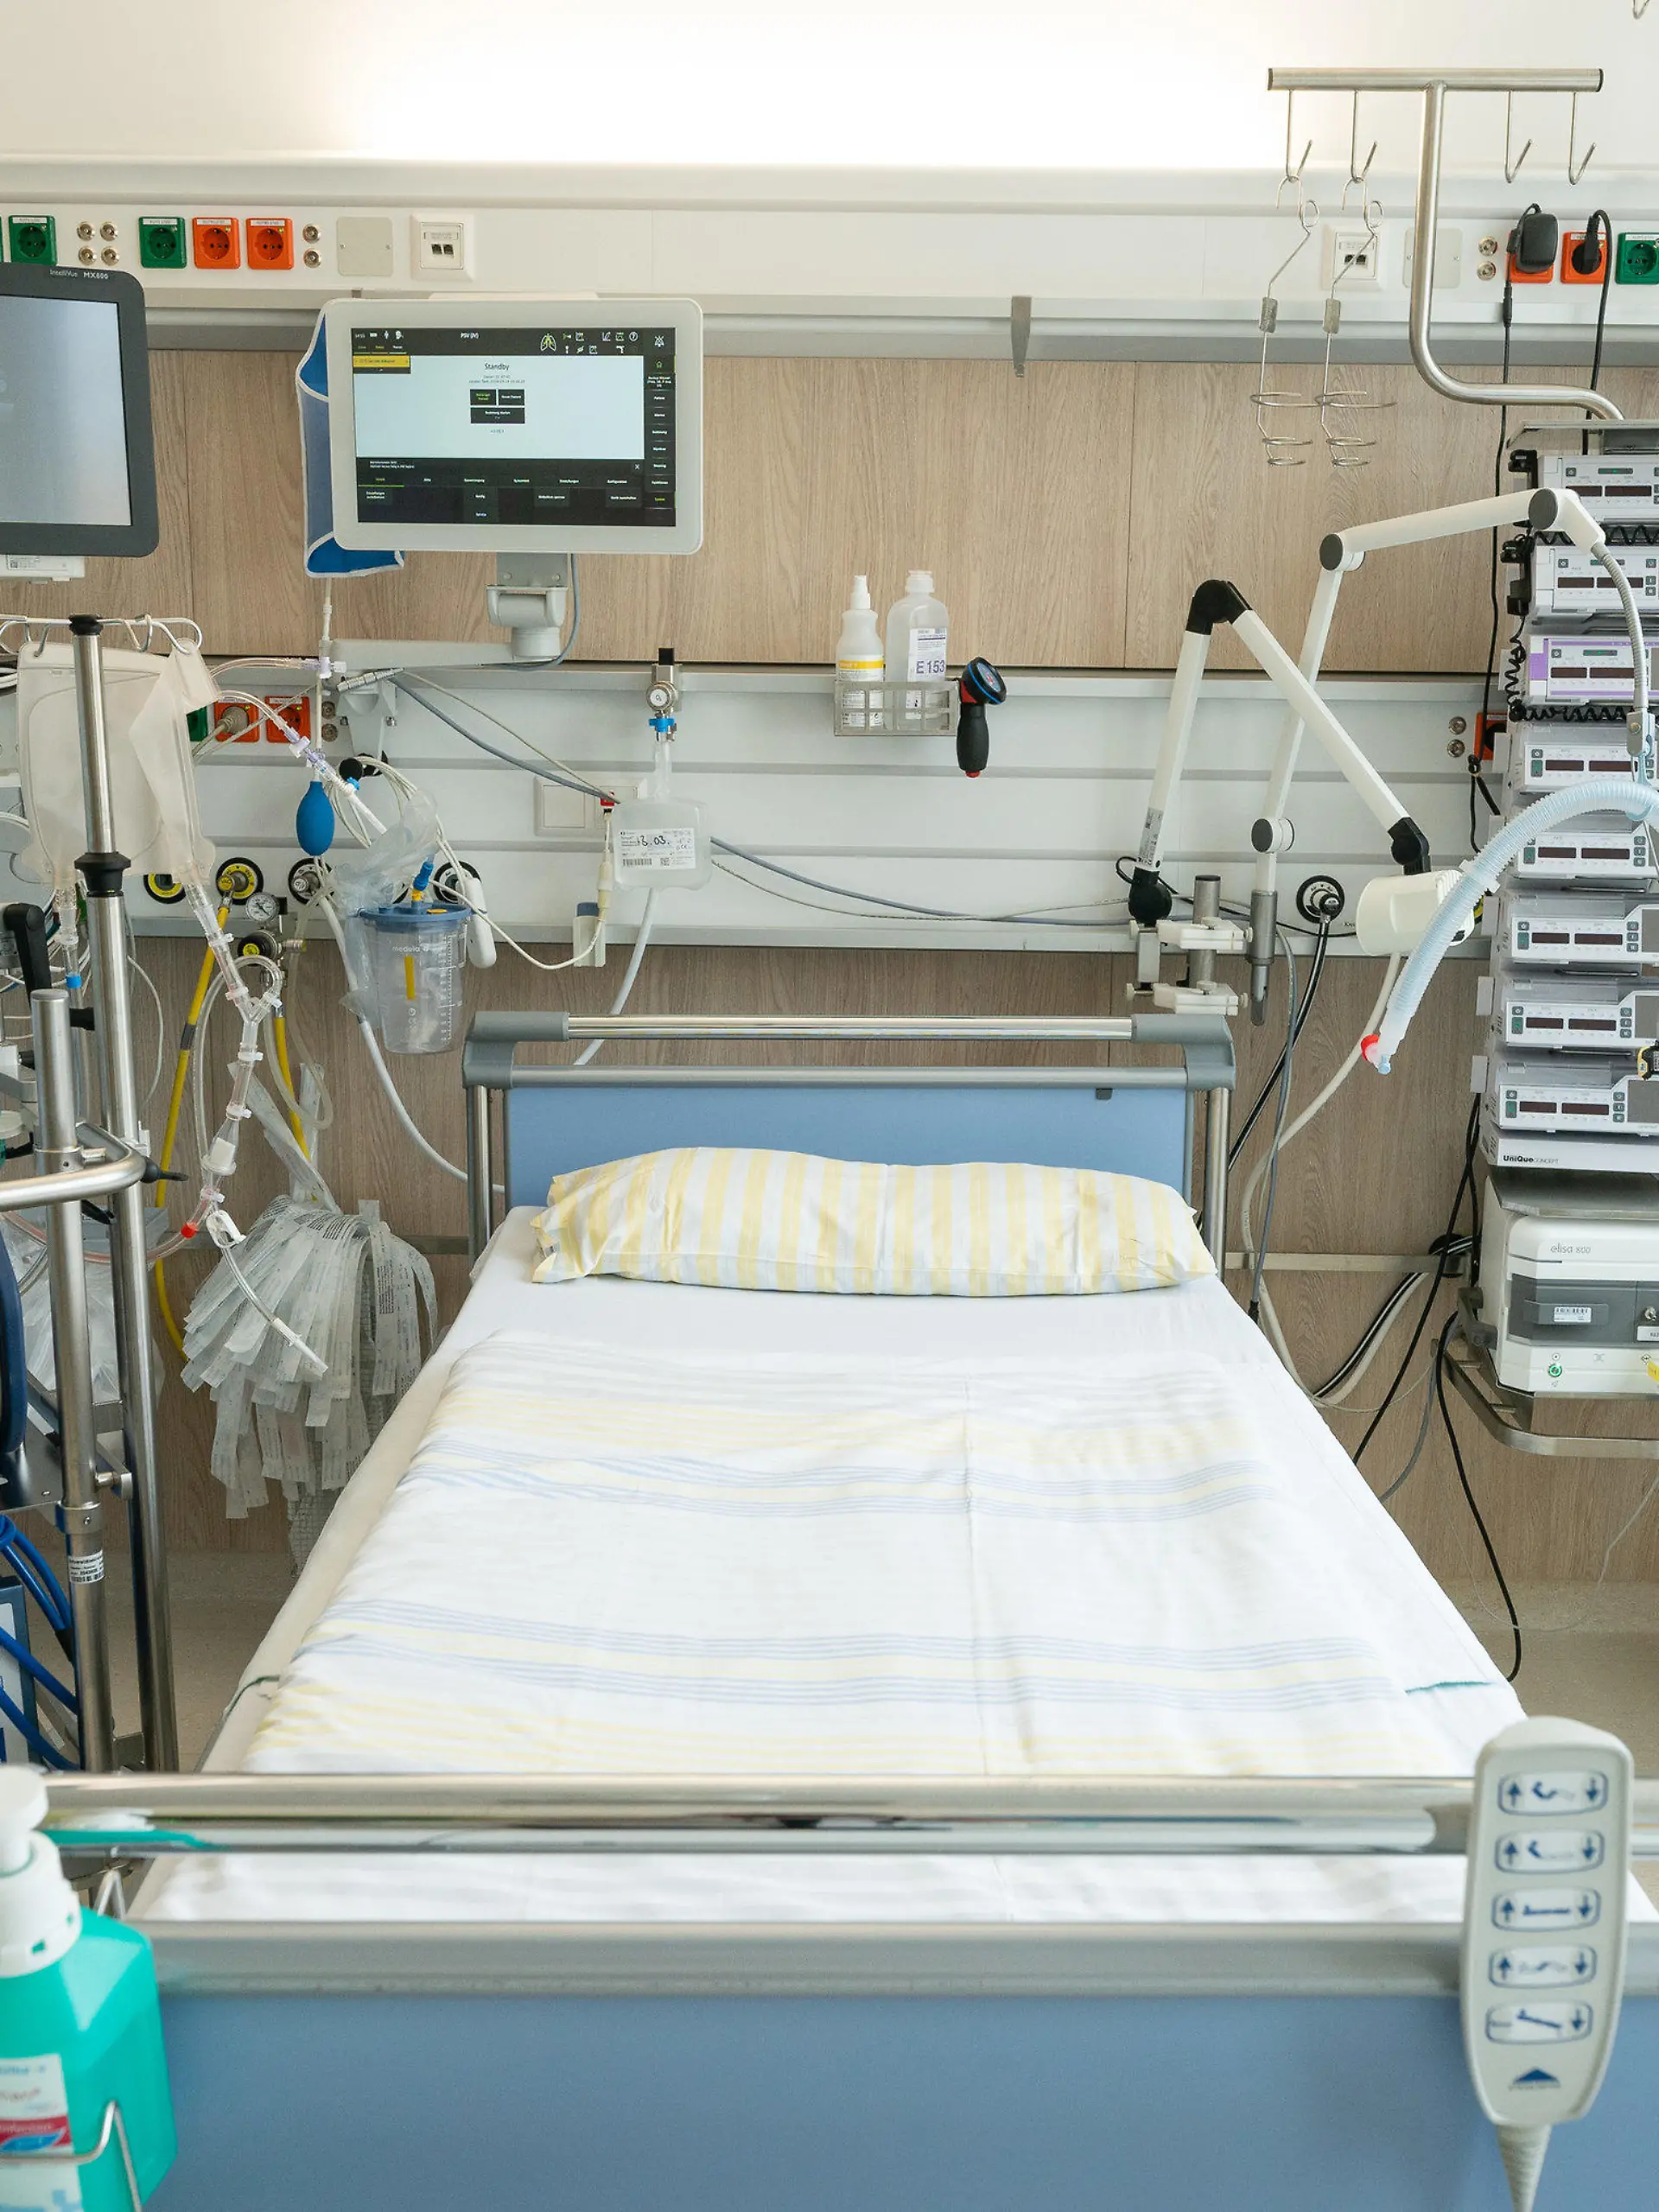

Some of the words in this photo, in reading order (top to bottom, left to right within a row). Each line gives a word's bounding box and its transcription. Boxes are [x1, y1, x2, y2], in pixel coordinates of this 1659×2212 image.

[484, 362, 510, 371] Standby
[916, 660, 925, 674] E
[926, 659, 945, 674] 153
[1550, 1243, 1573, 1254] elisa
